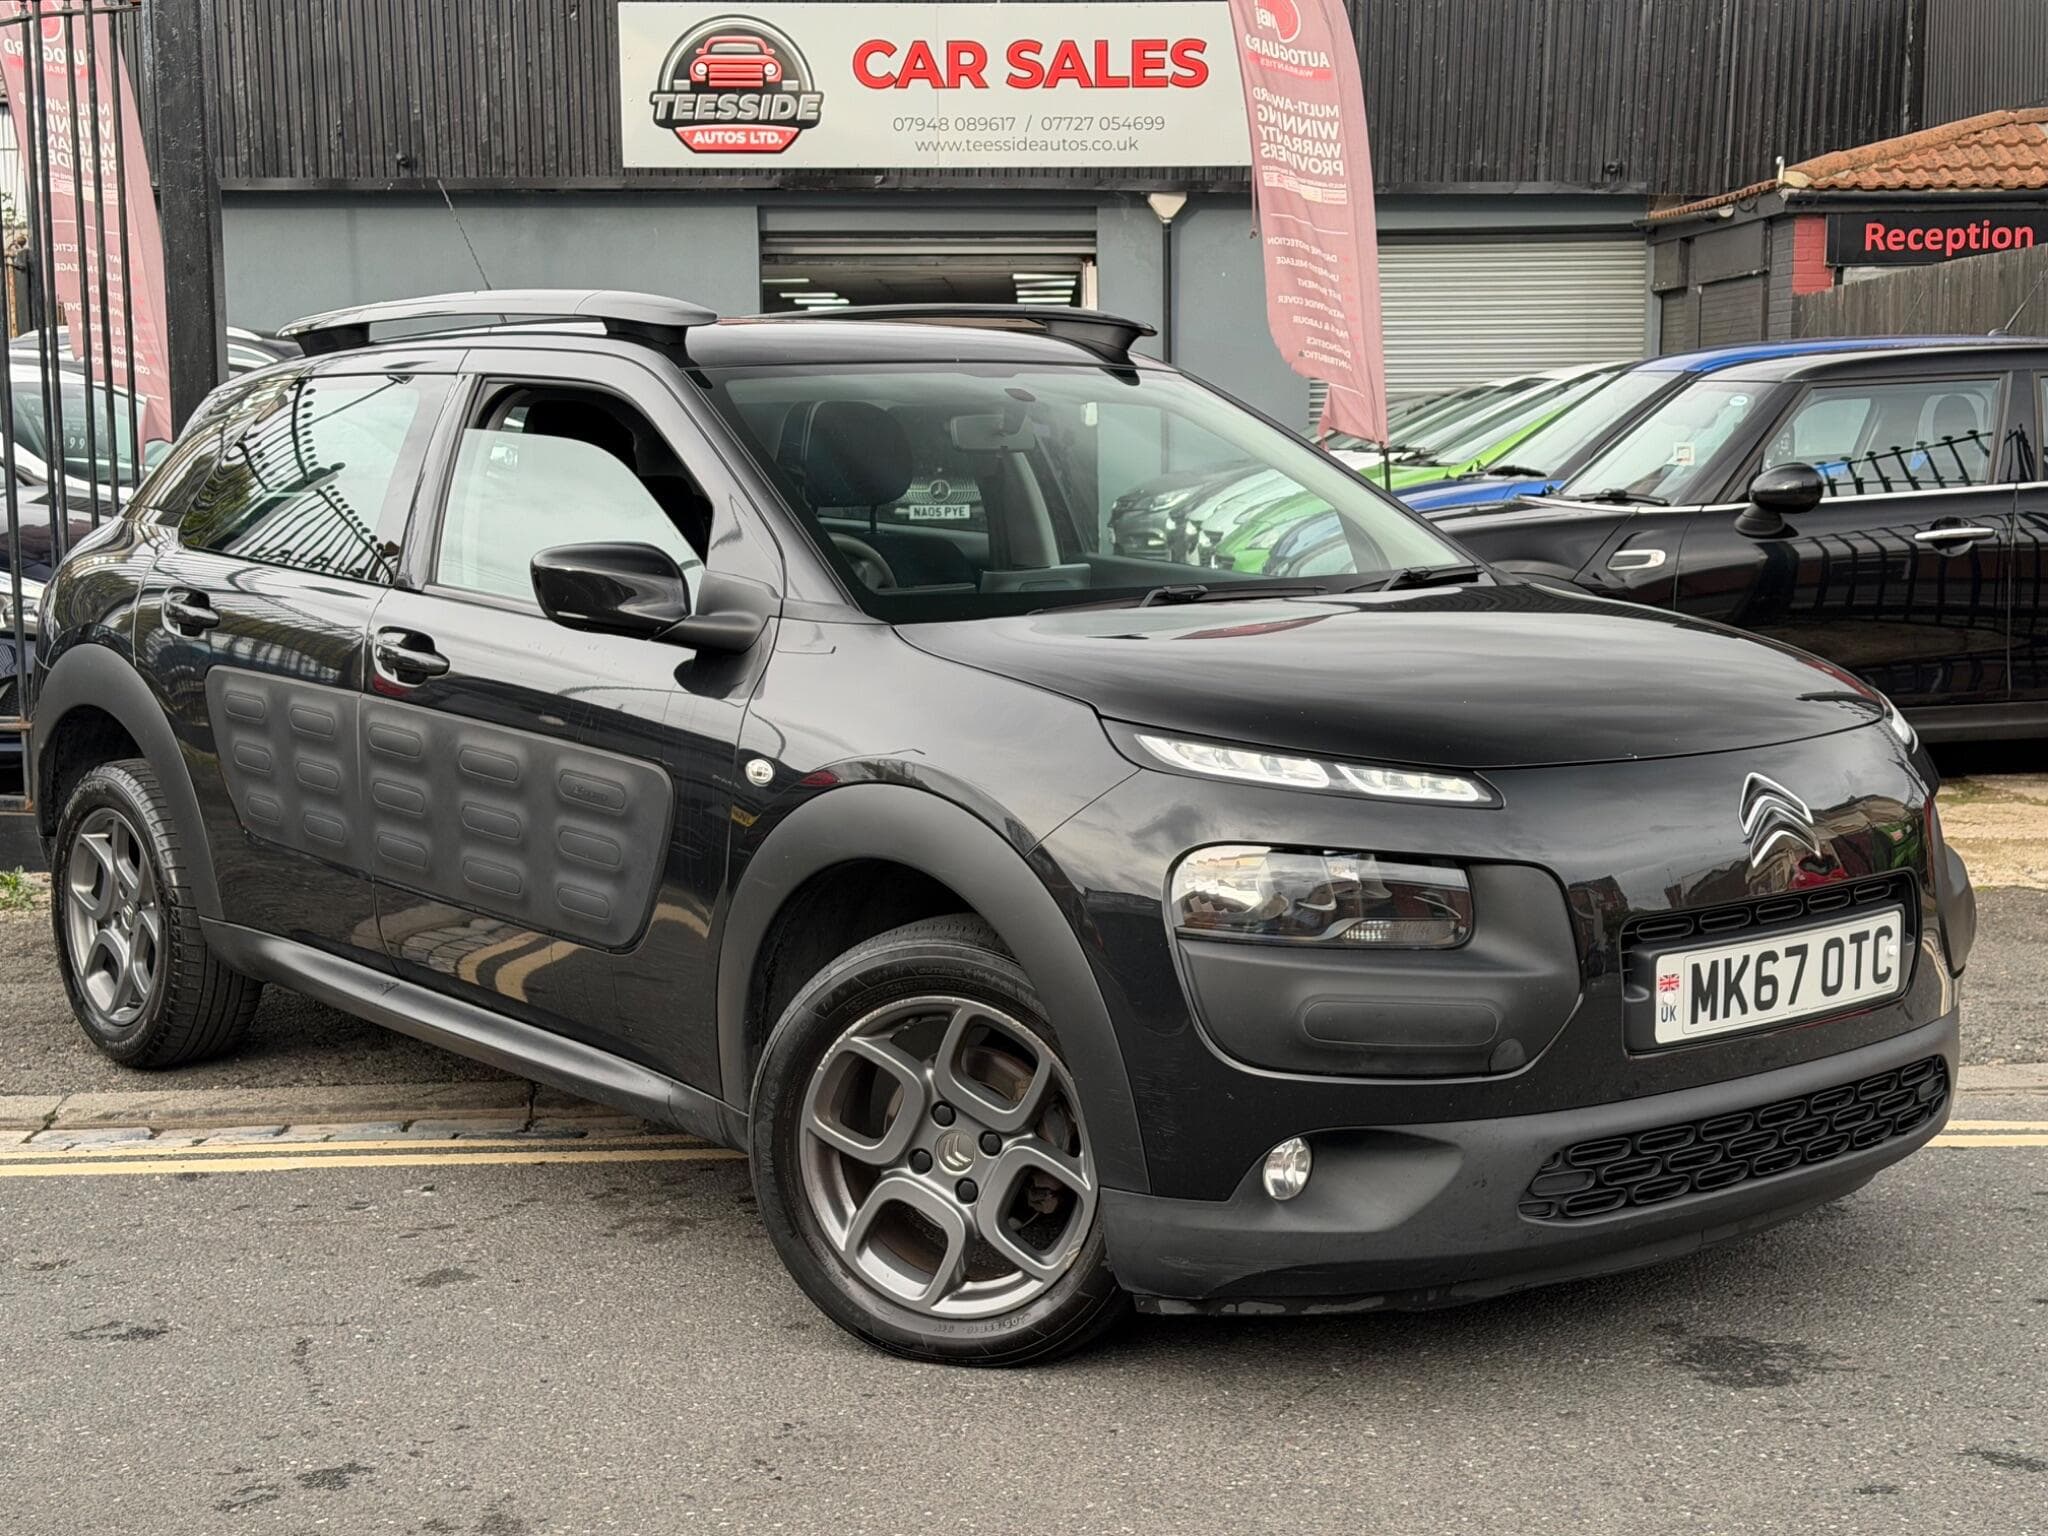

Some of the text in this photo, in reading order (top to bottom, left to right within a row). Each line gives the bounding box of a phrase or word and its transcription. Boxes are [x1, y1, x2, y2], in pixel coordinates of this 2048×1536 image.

[852, 38, 1209, 89] CAR SALES
[652, 93, 822, 120] TEESSIDE
[892, 115, 1165, 132] 07948 089617 / 07727 054699
[693, 131, 782, 144] AUTOS LTD.
[915, 136, 1139, 152] www.teessideautos.co.uk
[1865, 219, 2034, 256] Reception
[944, 507, 965, 517] PYE
[1689, 925, 1893, 1025] MK67 OTC
[1660, 1005, 1677, 1023] UK
